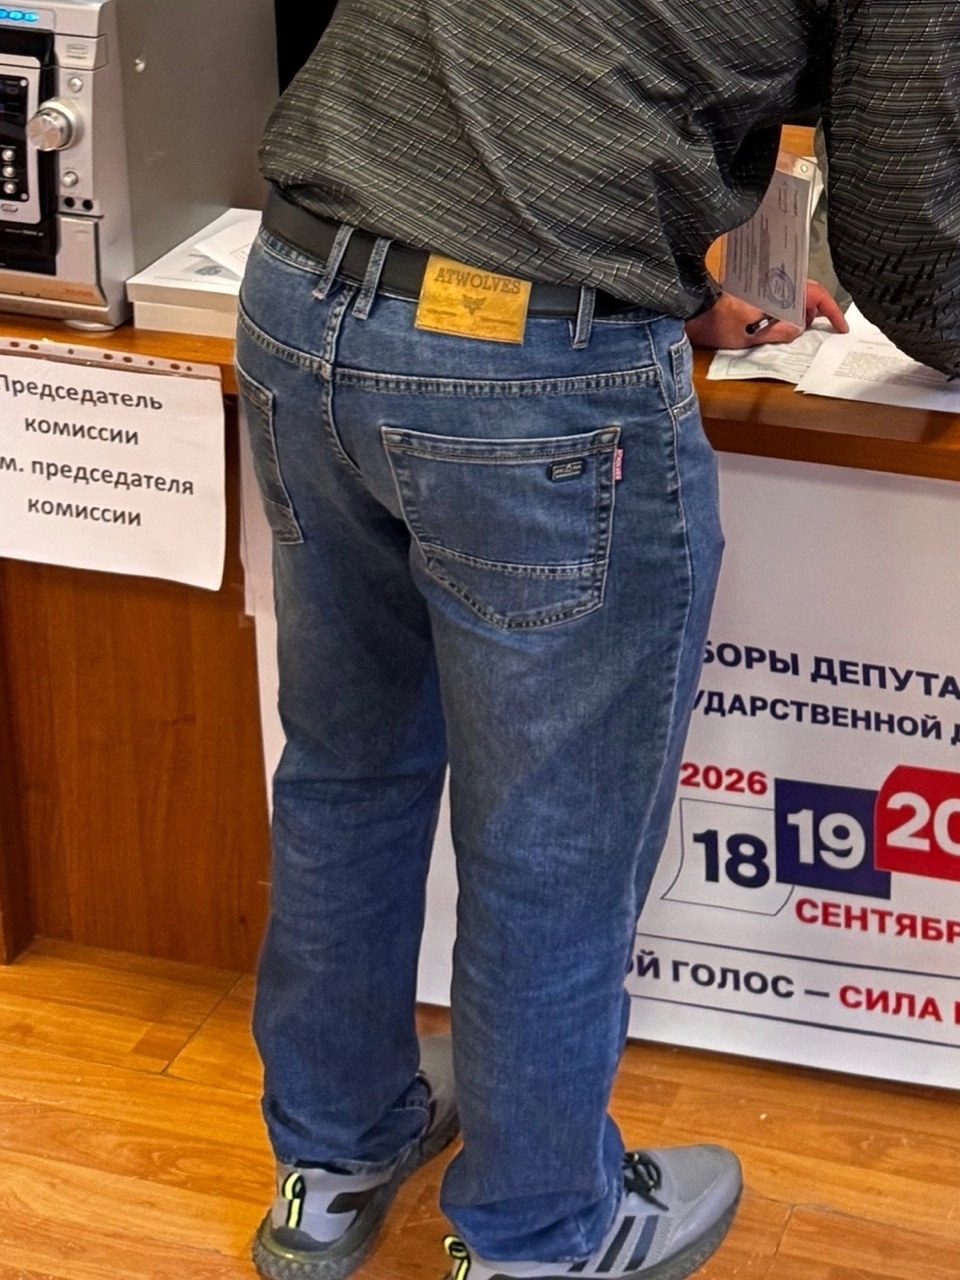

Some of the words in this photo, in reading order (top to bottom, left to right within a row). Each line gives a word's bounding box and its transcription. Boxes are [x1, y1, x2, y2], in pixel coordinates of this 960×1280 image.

[433, 267, 521, 295] ATWOLVES
[24, 416, 139, 446] комиссии
[31, 459, 194, 496] председателя
[27, 497, 142, 527] комиссии
[680, 761, 768, 796] 2026
[692, 828, 771, 889] 18
[787, 808, 867, 871] 19
[671, 959, 796, 999] ГОЛОС
[838, 984, 944, 1023] СИЛА
